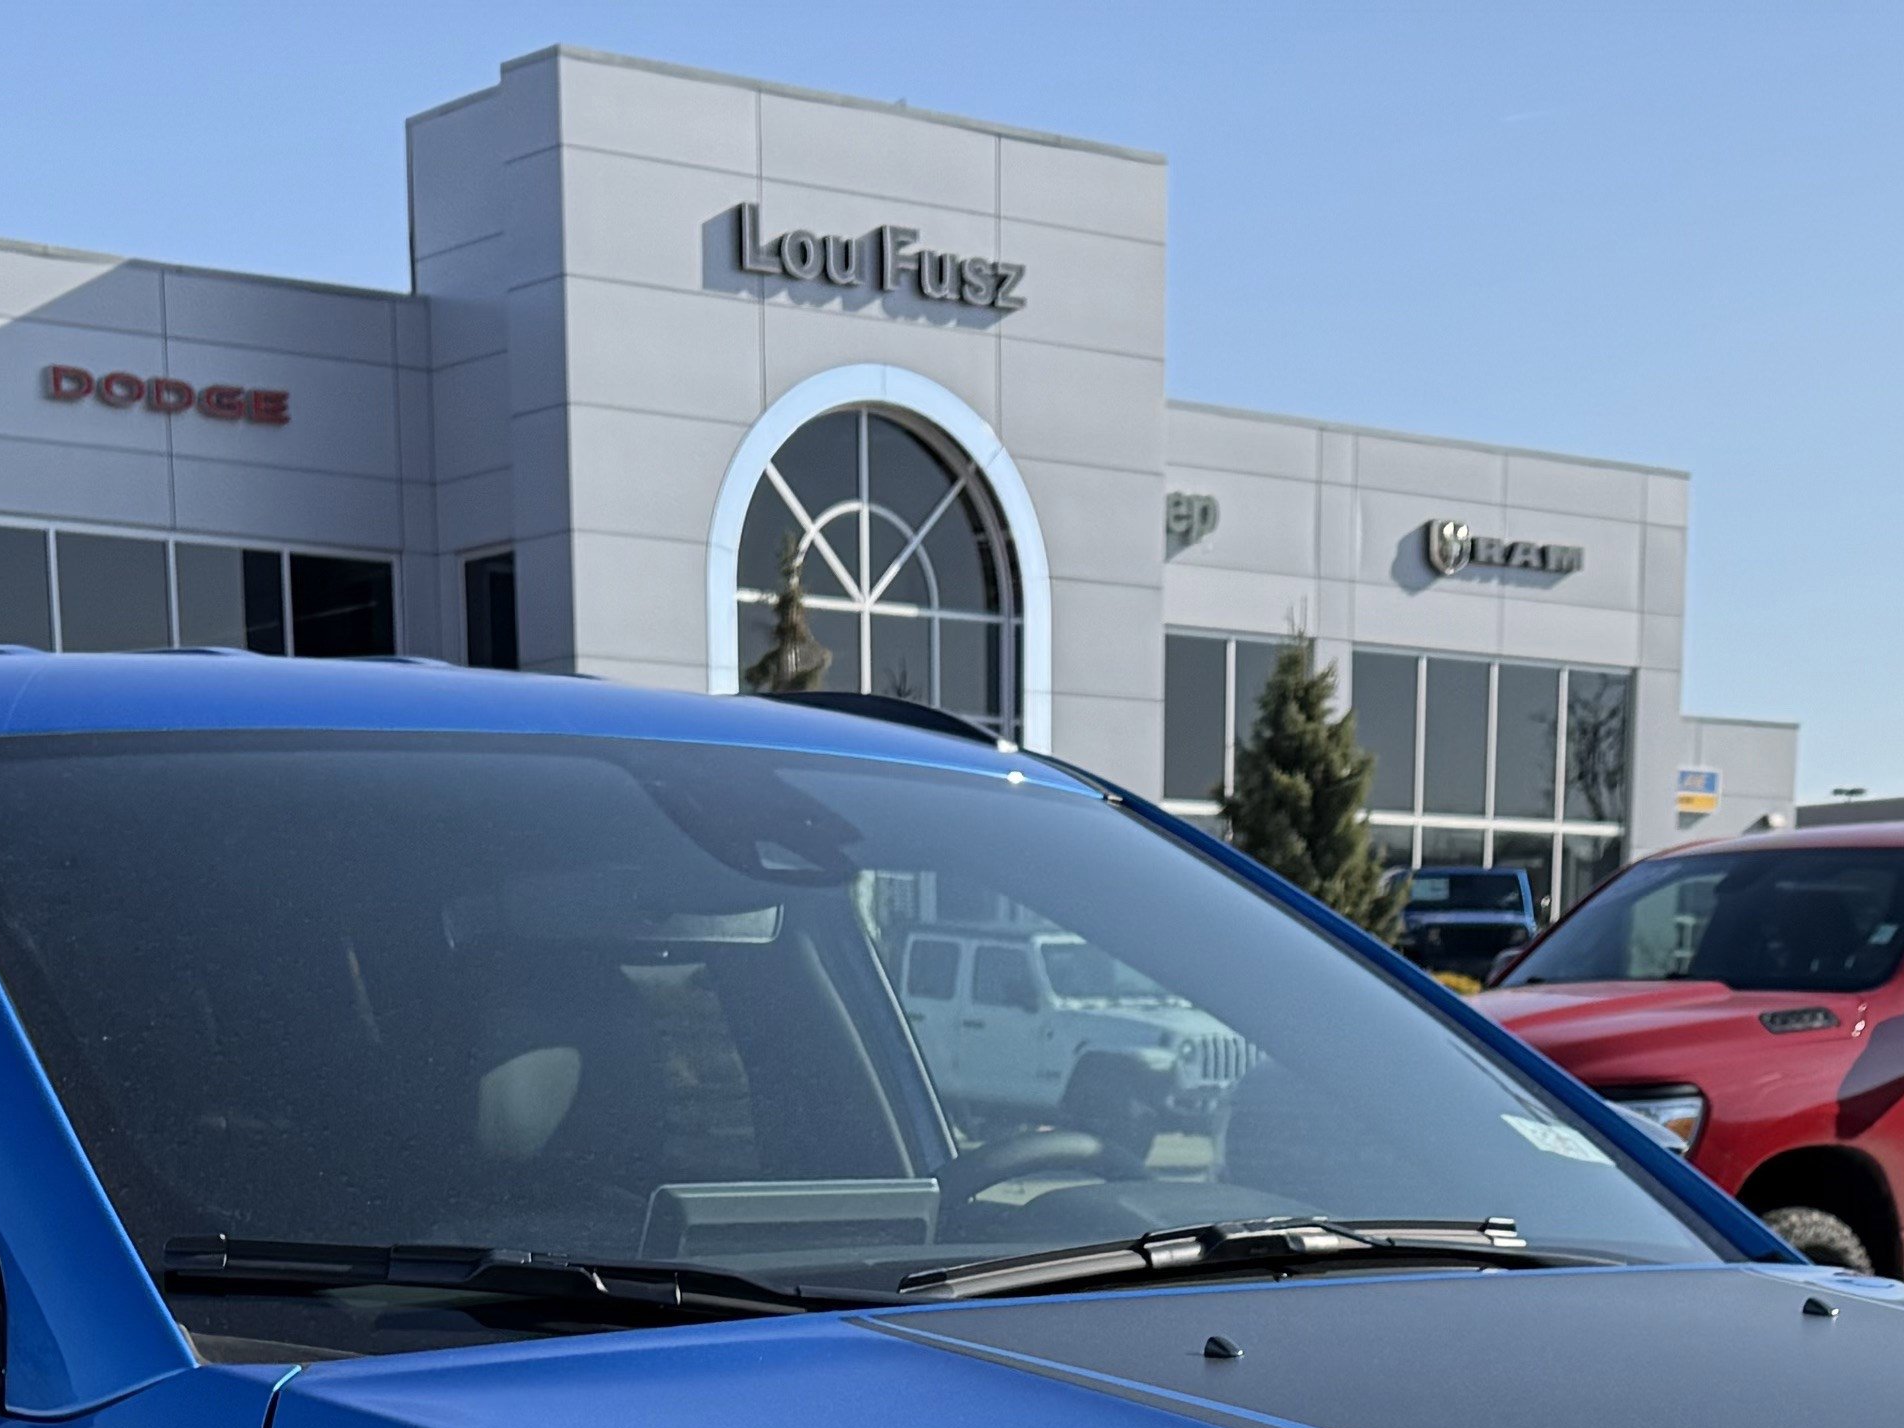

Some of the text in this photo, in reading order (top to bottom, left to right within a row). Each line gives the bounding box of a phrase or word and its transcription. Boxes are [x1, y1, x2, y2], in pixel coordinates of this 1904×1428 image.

[740, 201, 1027, 309] Lou Fusz
[41, 363, 291, 425] DODGE
[1165, 491, 1219, 537] ep
[1469, 535, 1586, 573] RAM
